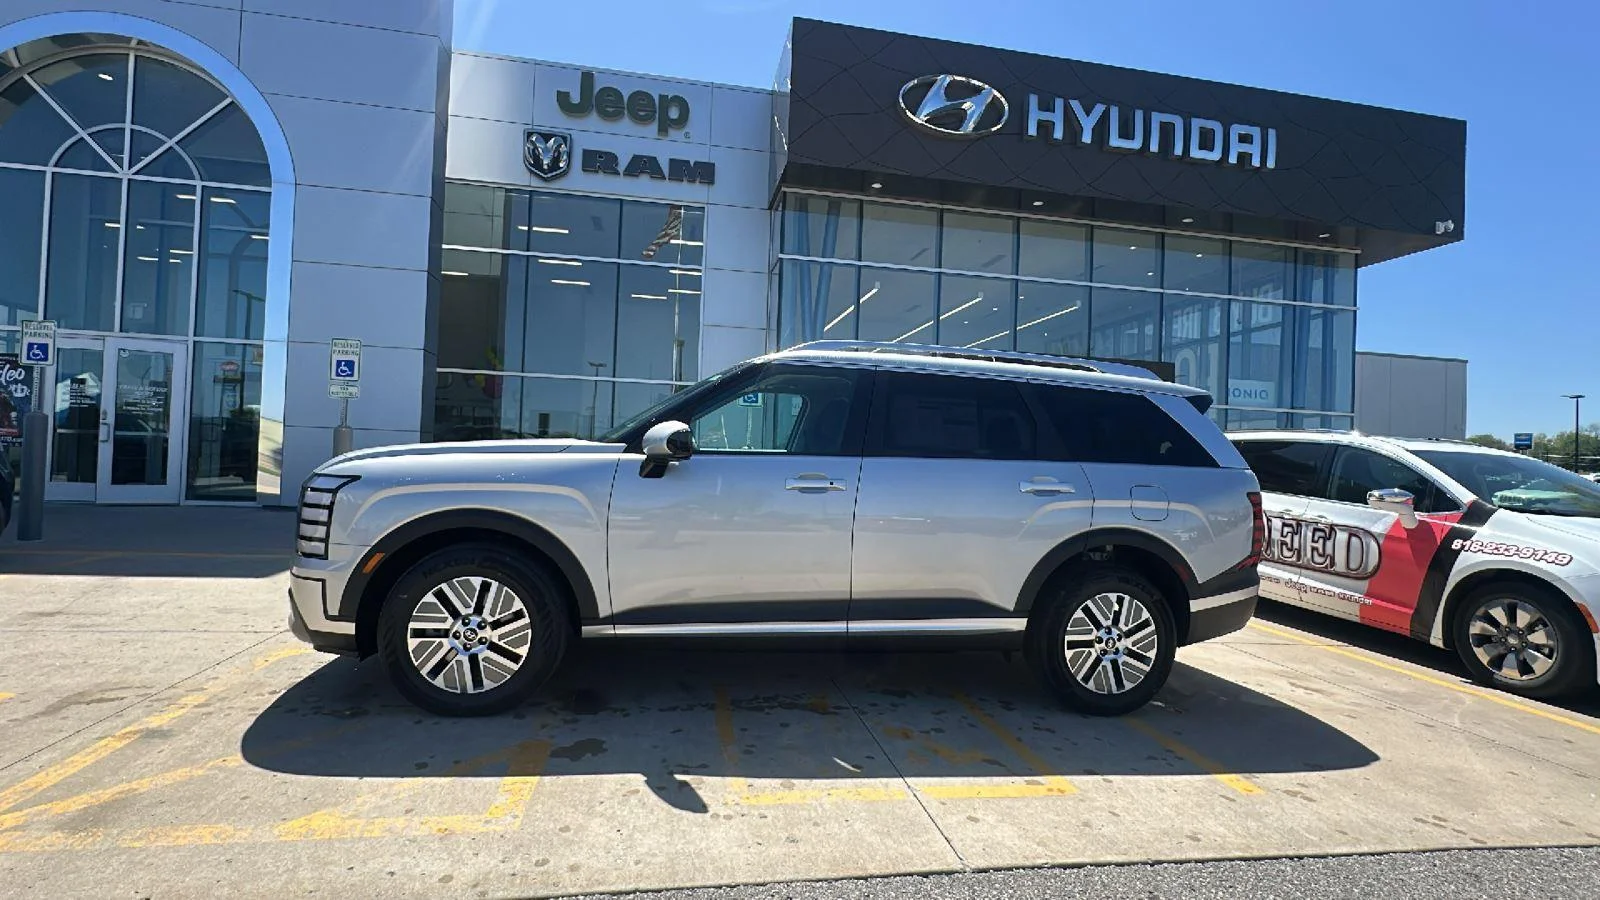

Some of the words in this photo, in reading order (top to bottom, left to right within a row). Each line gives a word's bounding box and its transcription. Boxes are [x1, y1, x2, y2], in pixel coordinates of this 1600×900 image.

[557, 71, 690, 137] Jeep
[1027, 93, 1277, 170] HYUNDAI
[582, 148, 716, 185] RAM
[1451, 539, 1574, 567] 816-233-9149
